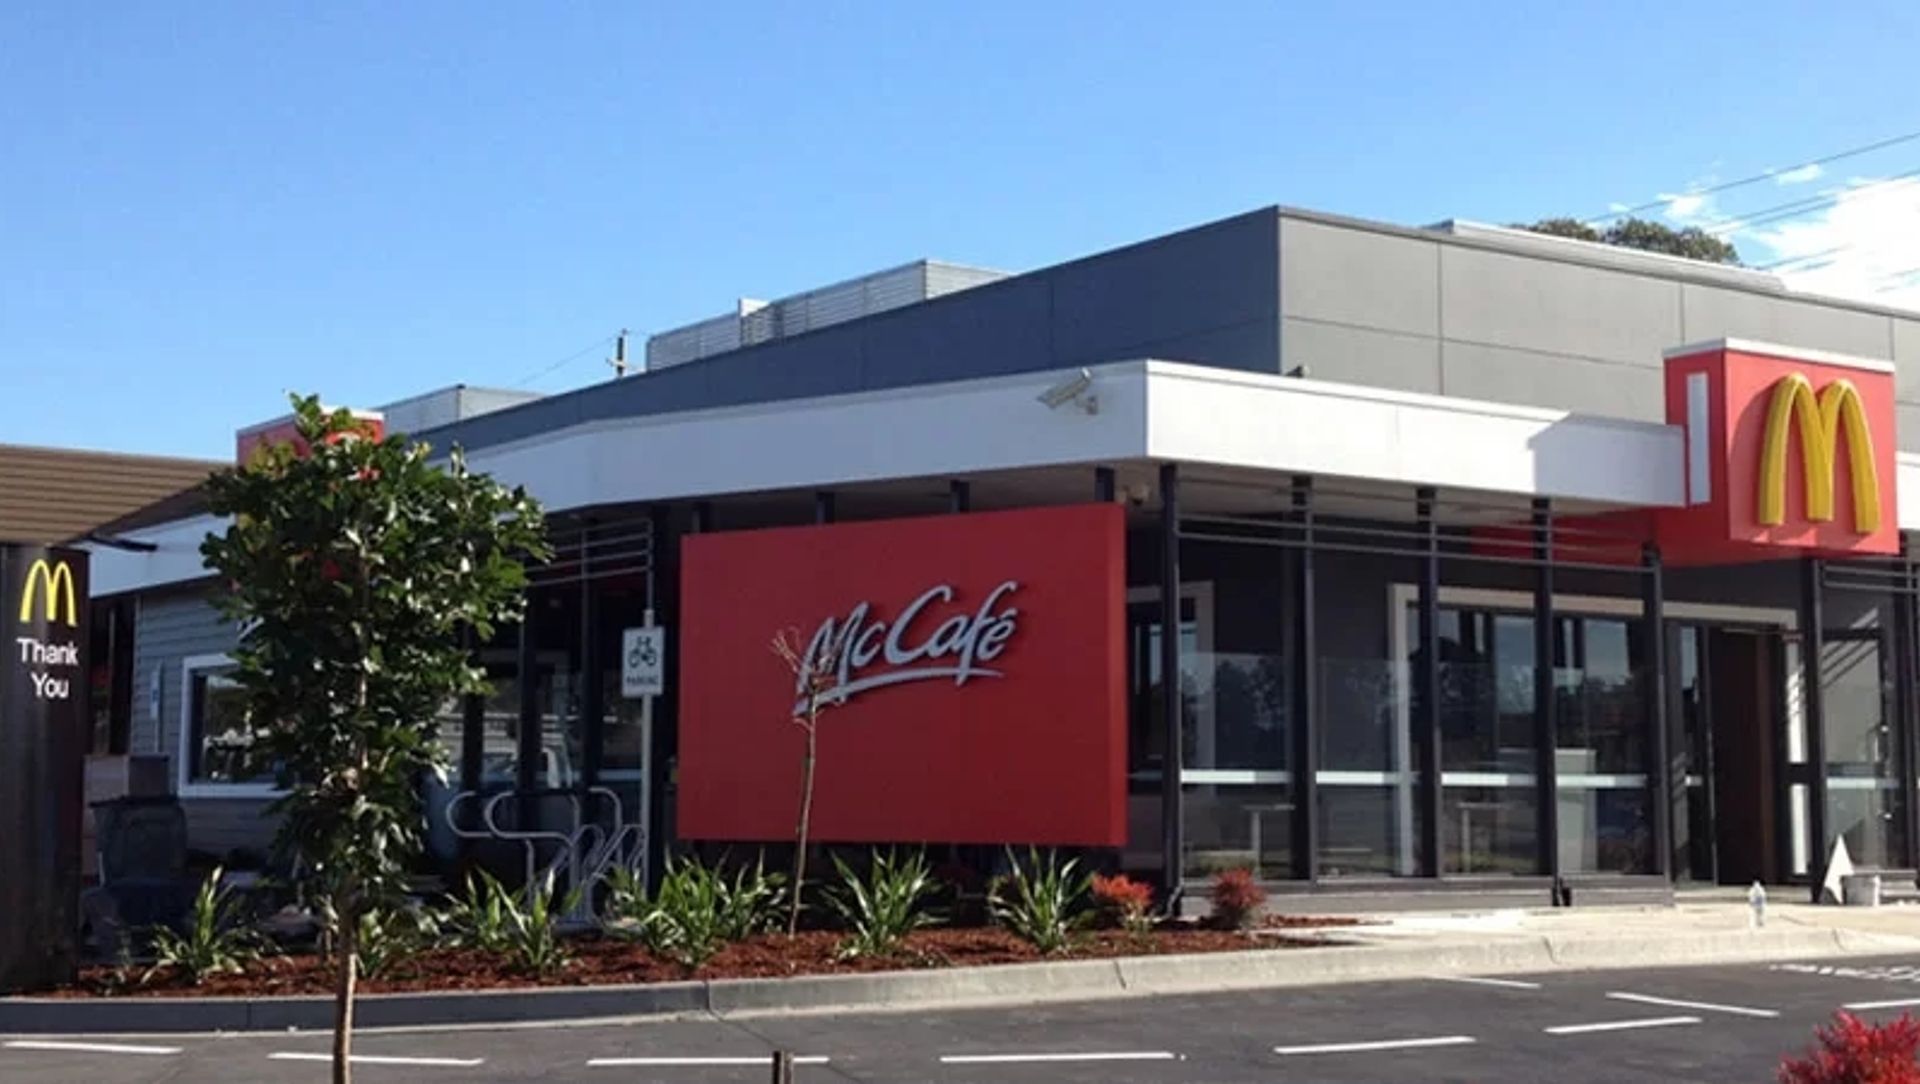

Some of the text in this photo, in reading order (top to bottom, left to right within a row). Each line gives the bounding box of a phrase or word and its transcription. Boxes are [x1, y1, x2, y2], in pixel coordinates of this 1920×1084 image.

[1759, 373, 1881, 533] M
[16, 637, 79, 665] Thank
[797, 580, 1018, 703] McCafé
[31, 672, 69, 698] You
